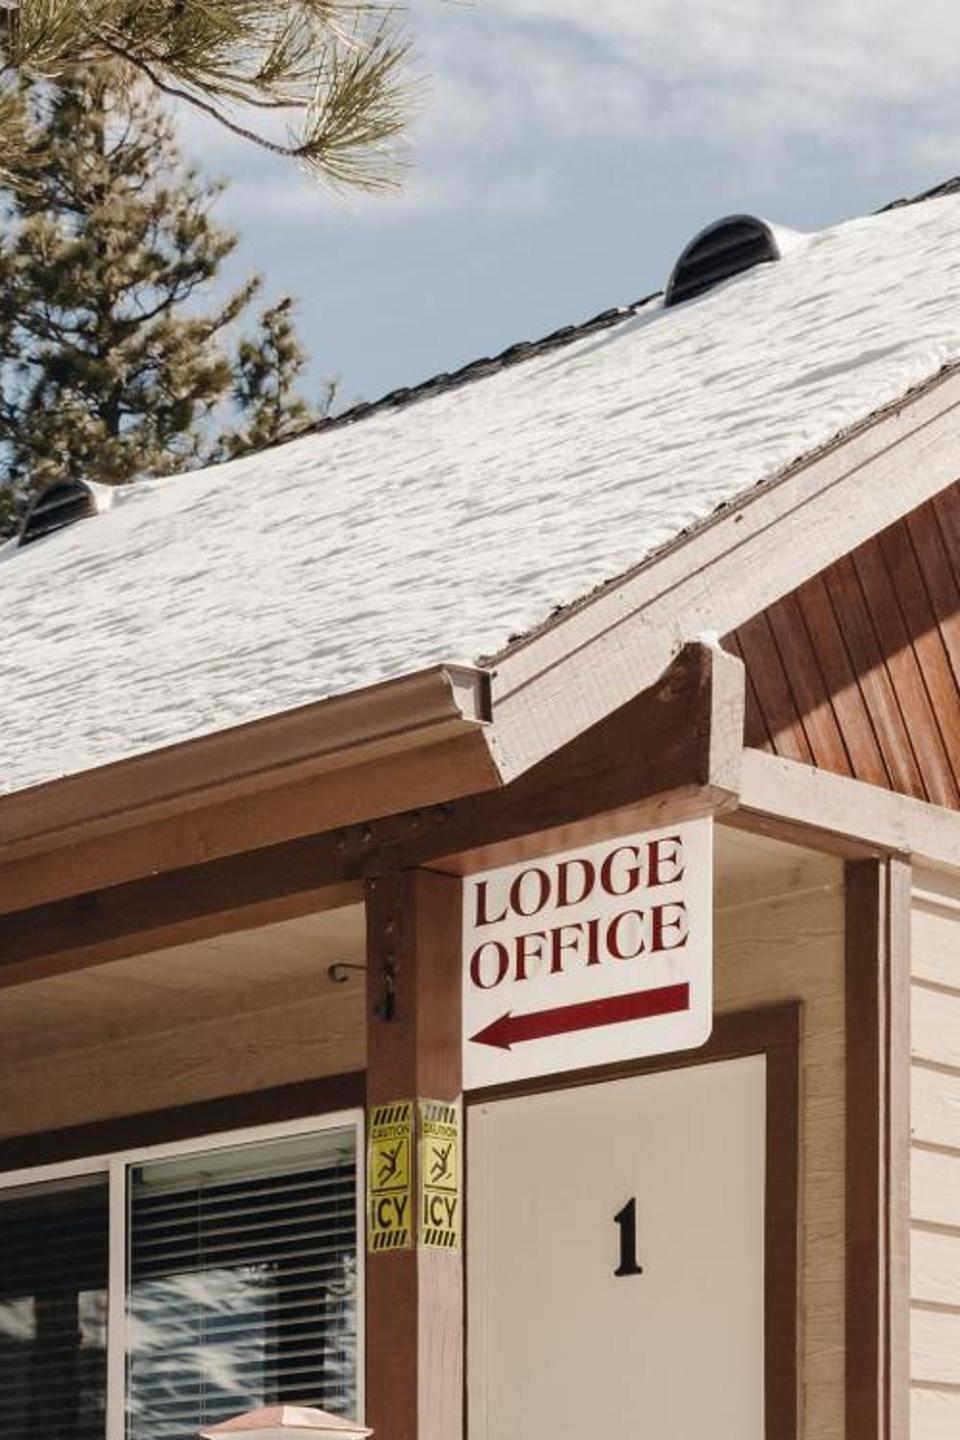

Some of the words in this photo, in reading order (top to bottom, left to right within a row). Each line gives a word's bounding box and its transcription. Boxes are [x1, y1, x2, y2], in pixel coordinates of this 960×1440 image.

[474, 835, 685, 928] LODGE
[469, 901, 690, 989] OFFICE
[372, 1125, 409, 1139] CAUTION
[371, 1195, 408, 1230] ICY
[423, 1194, 457, 1228] ICY
[613, 1197, 643, 1277] 1
